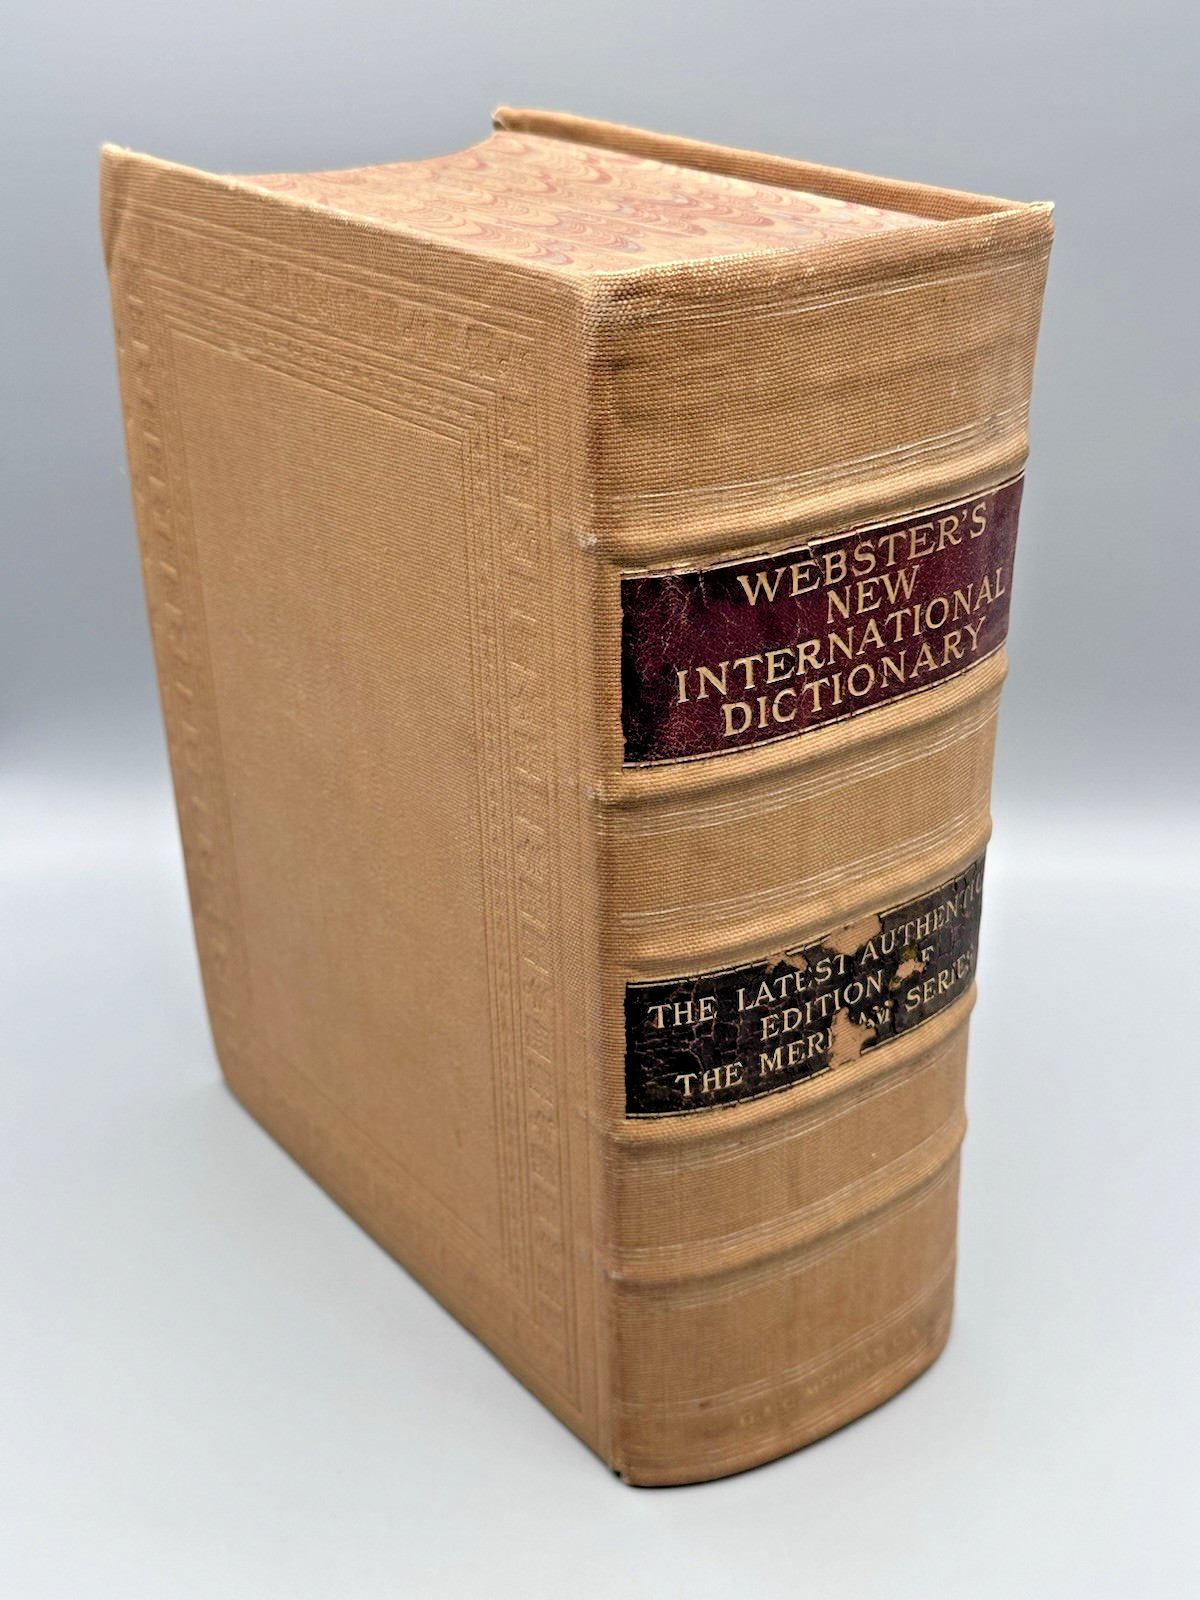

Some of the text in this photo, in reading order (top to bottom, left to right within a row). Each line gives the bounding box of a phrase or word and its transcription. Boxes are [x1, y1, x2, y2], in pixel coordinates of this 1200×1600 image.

[736, 501, 988, 606] WEBSTER'S
[826, 565, 920, 624] NEW
[675, 567, 1006, 705] INTERNATIONAL
[721, 615, 987, 737] DICTIONARY
[647, 996, 718, 1029] THE
[736, 953, 847, 1012] LATEST
[760, 969, 883, 1042] EDITION
[675, 1061, 744, 1098] THE
